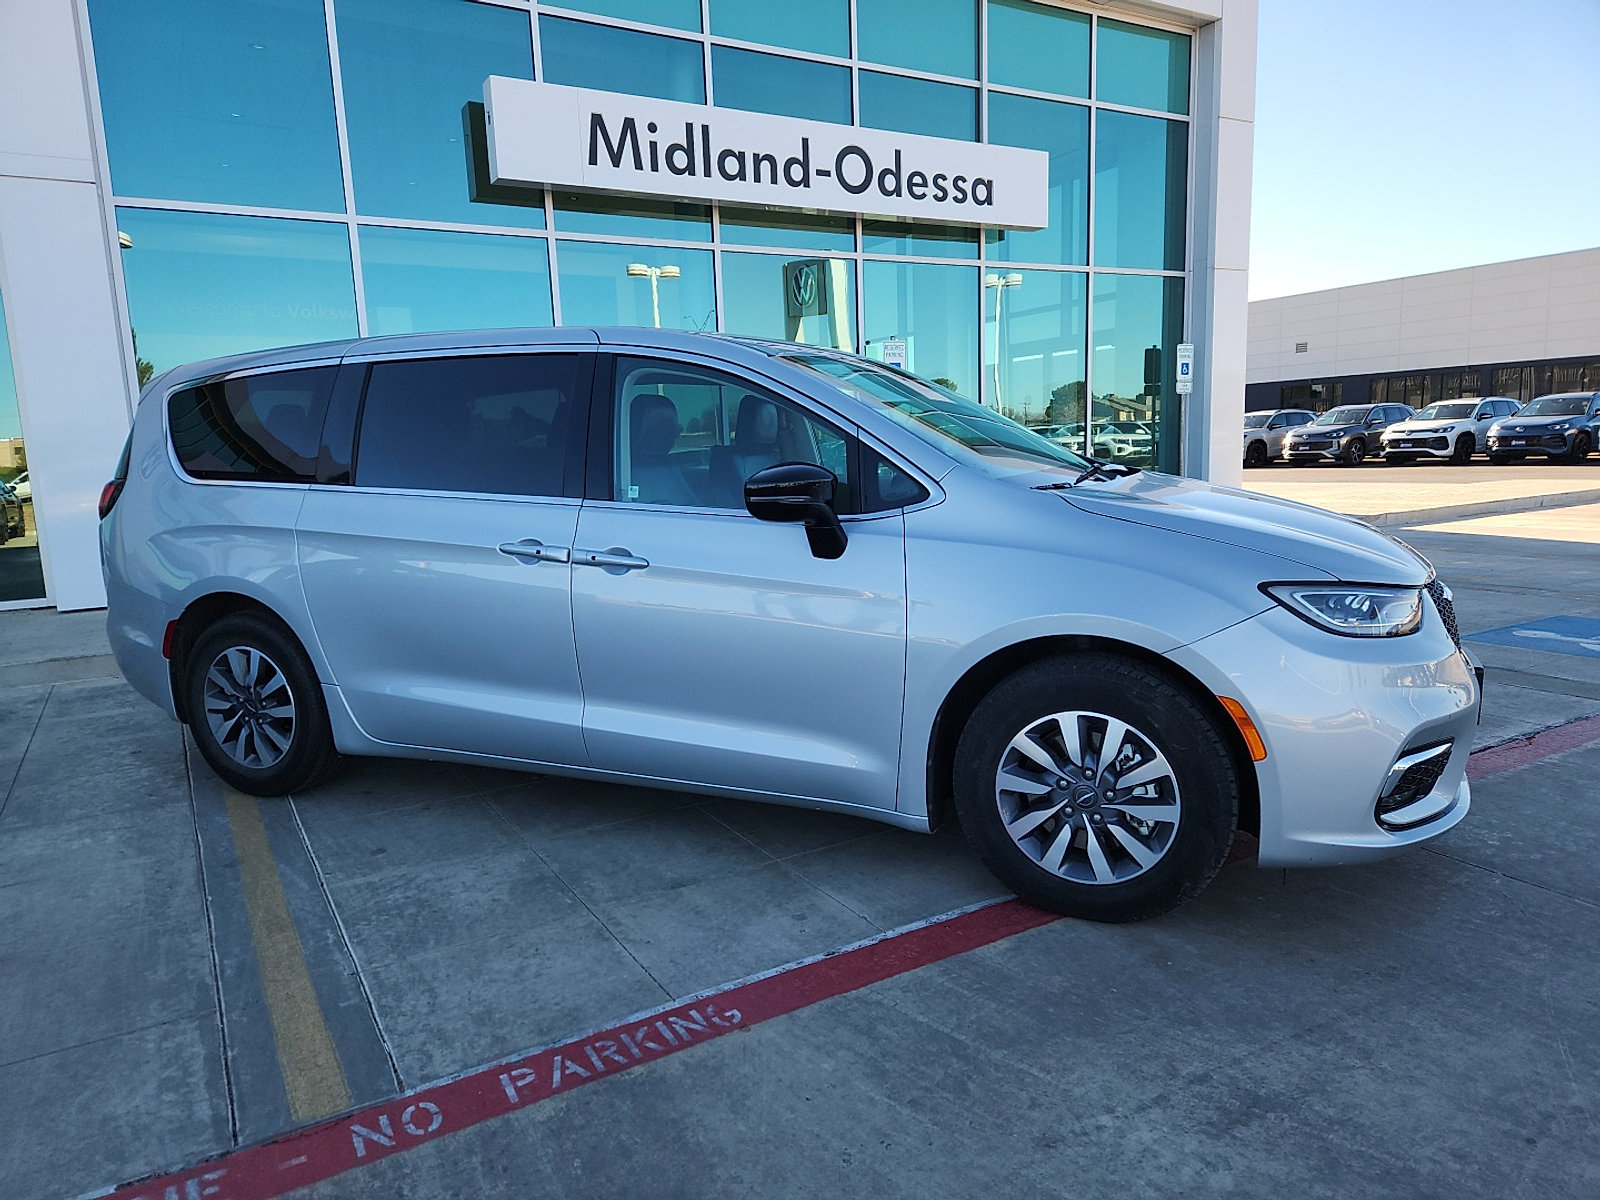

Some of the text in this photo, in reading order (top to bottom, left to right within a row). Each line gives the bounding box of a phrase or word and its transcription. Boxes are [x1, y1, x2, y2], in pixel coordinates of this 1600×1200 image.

[588, 113, 994, 206] Midland-Odessa
[286, 303, 357, 320] Volksw
[350, 1101, 443, 1158] NO
[499, 1004, 743, 1104] PARKING
